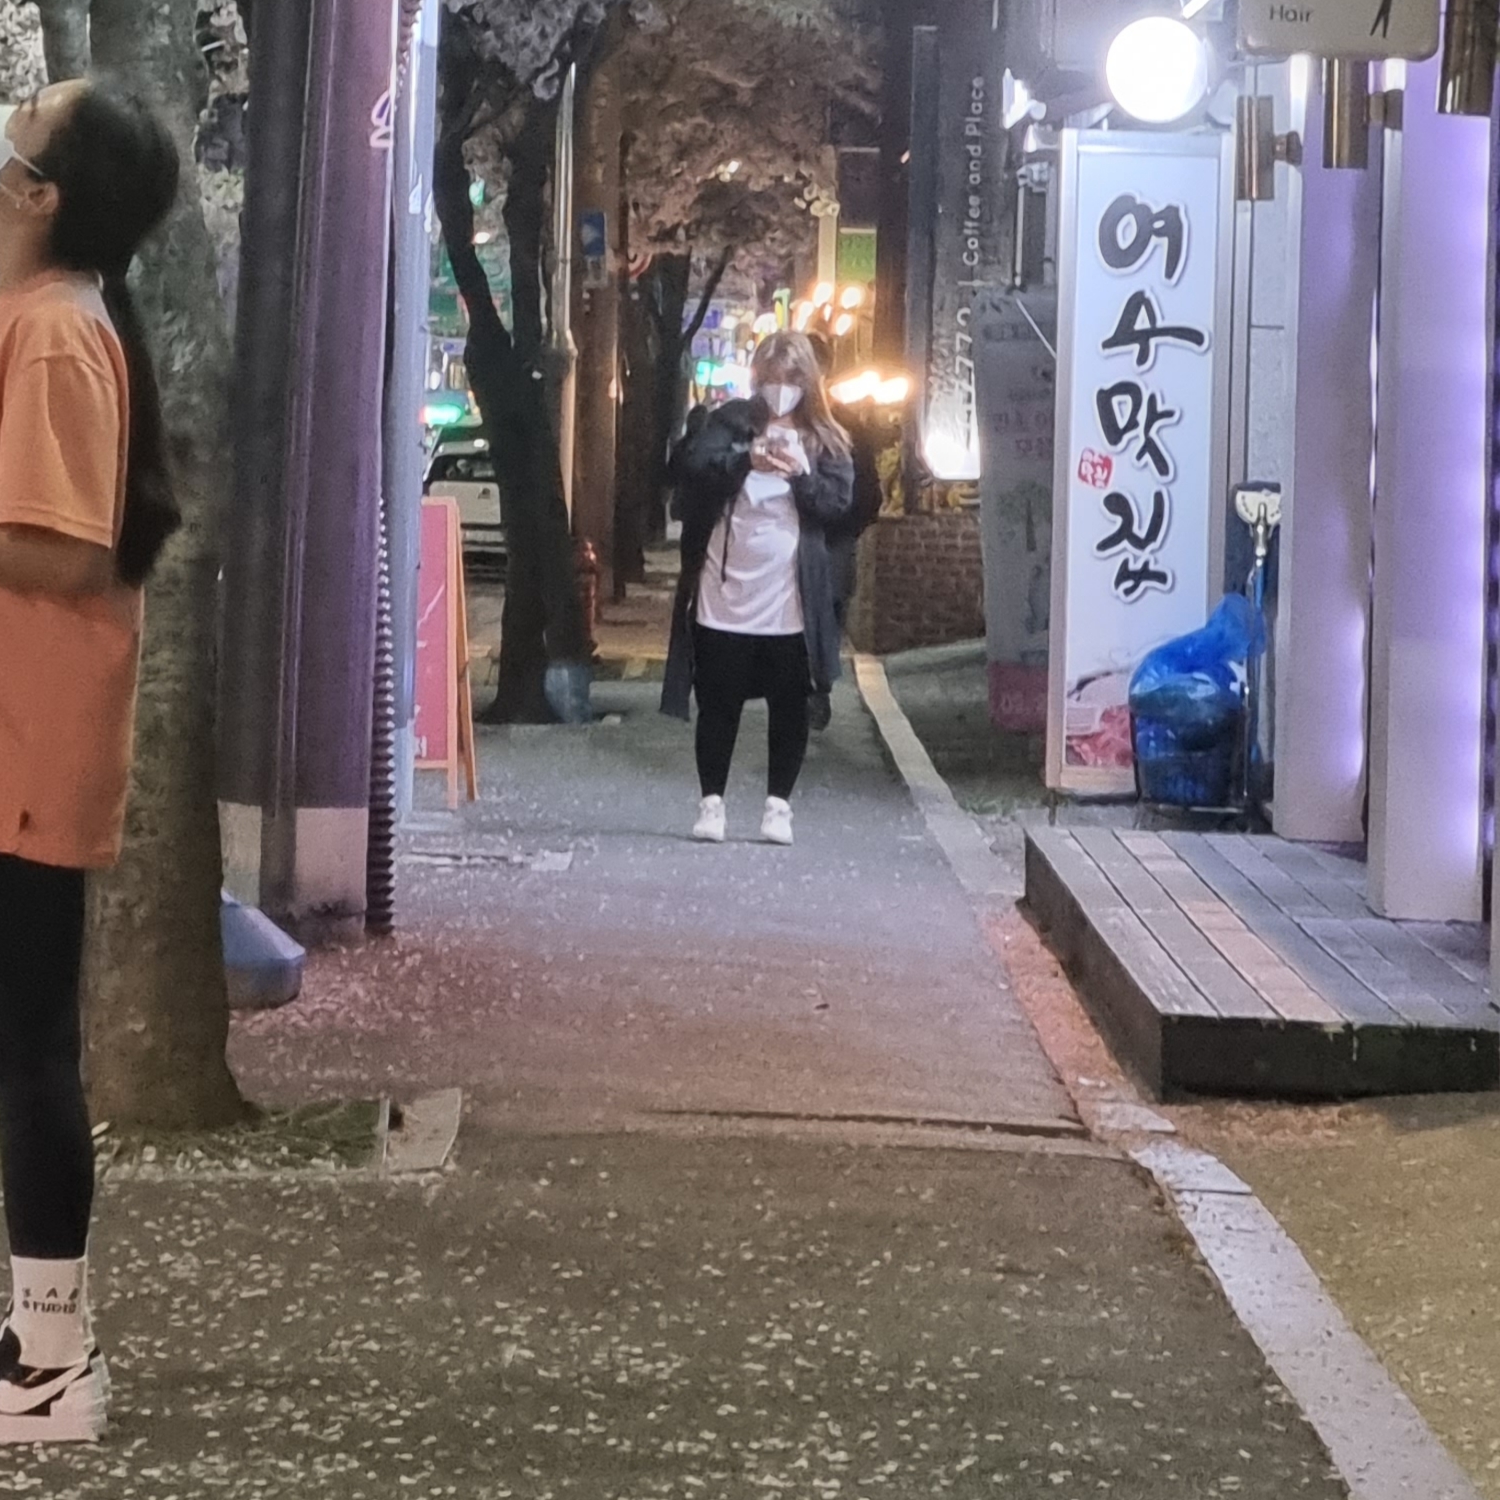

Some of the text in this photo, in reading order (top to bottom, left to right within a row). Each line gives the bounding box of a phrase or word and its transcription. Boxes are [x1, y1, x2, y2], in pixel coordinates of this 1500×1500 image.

[1269, 3, 1314, 23] Hair
[962, 75, 985, 267] Coffee and Place
